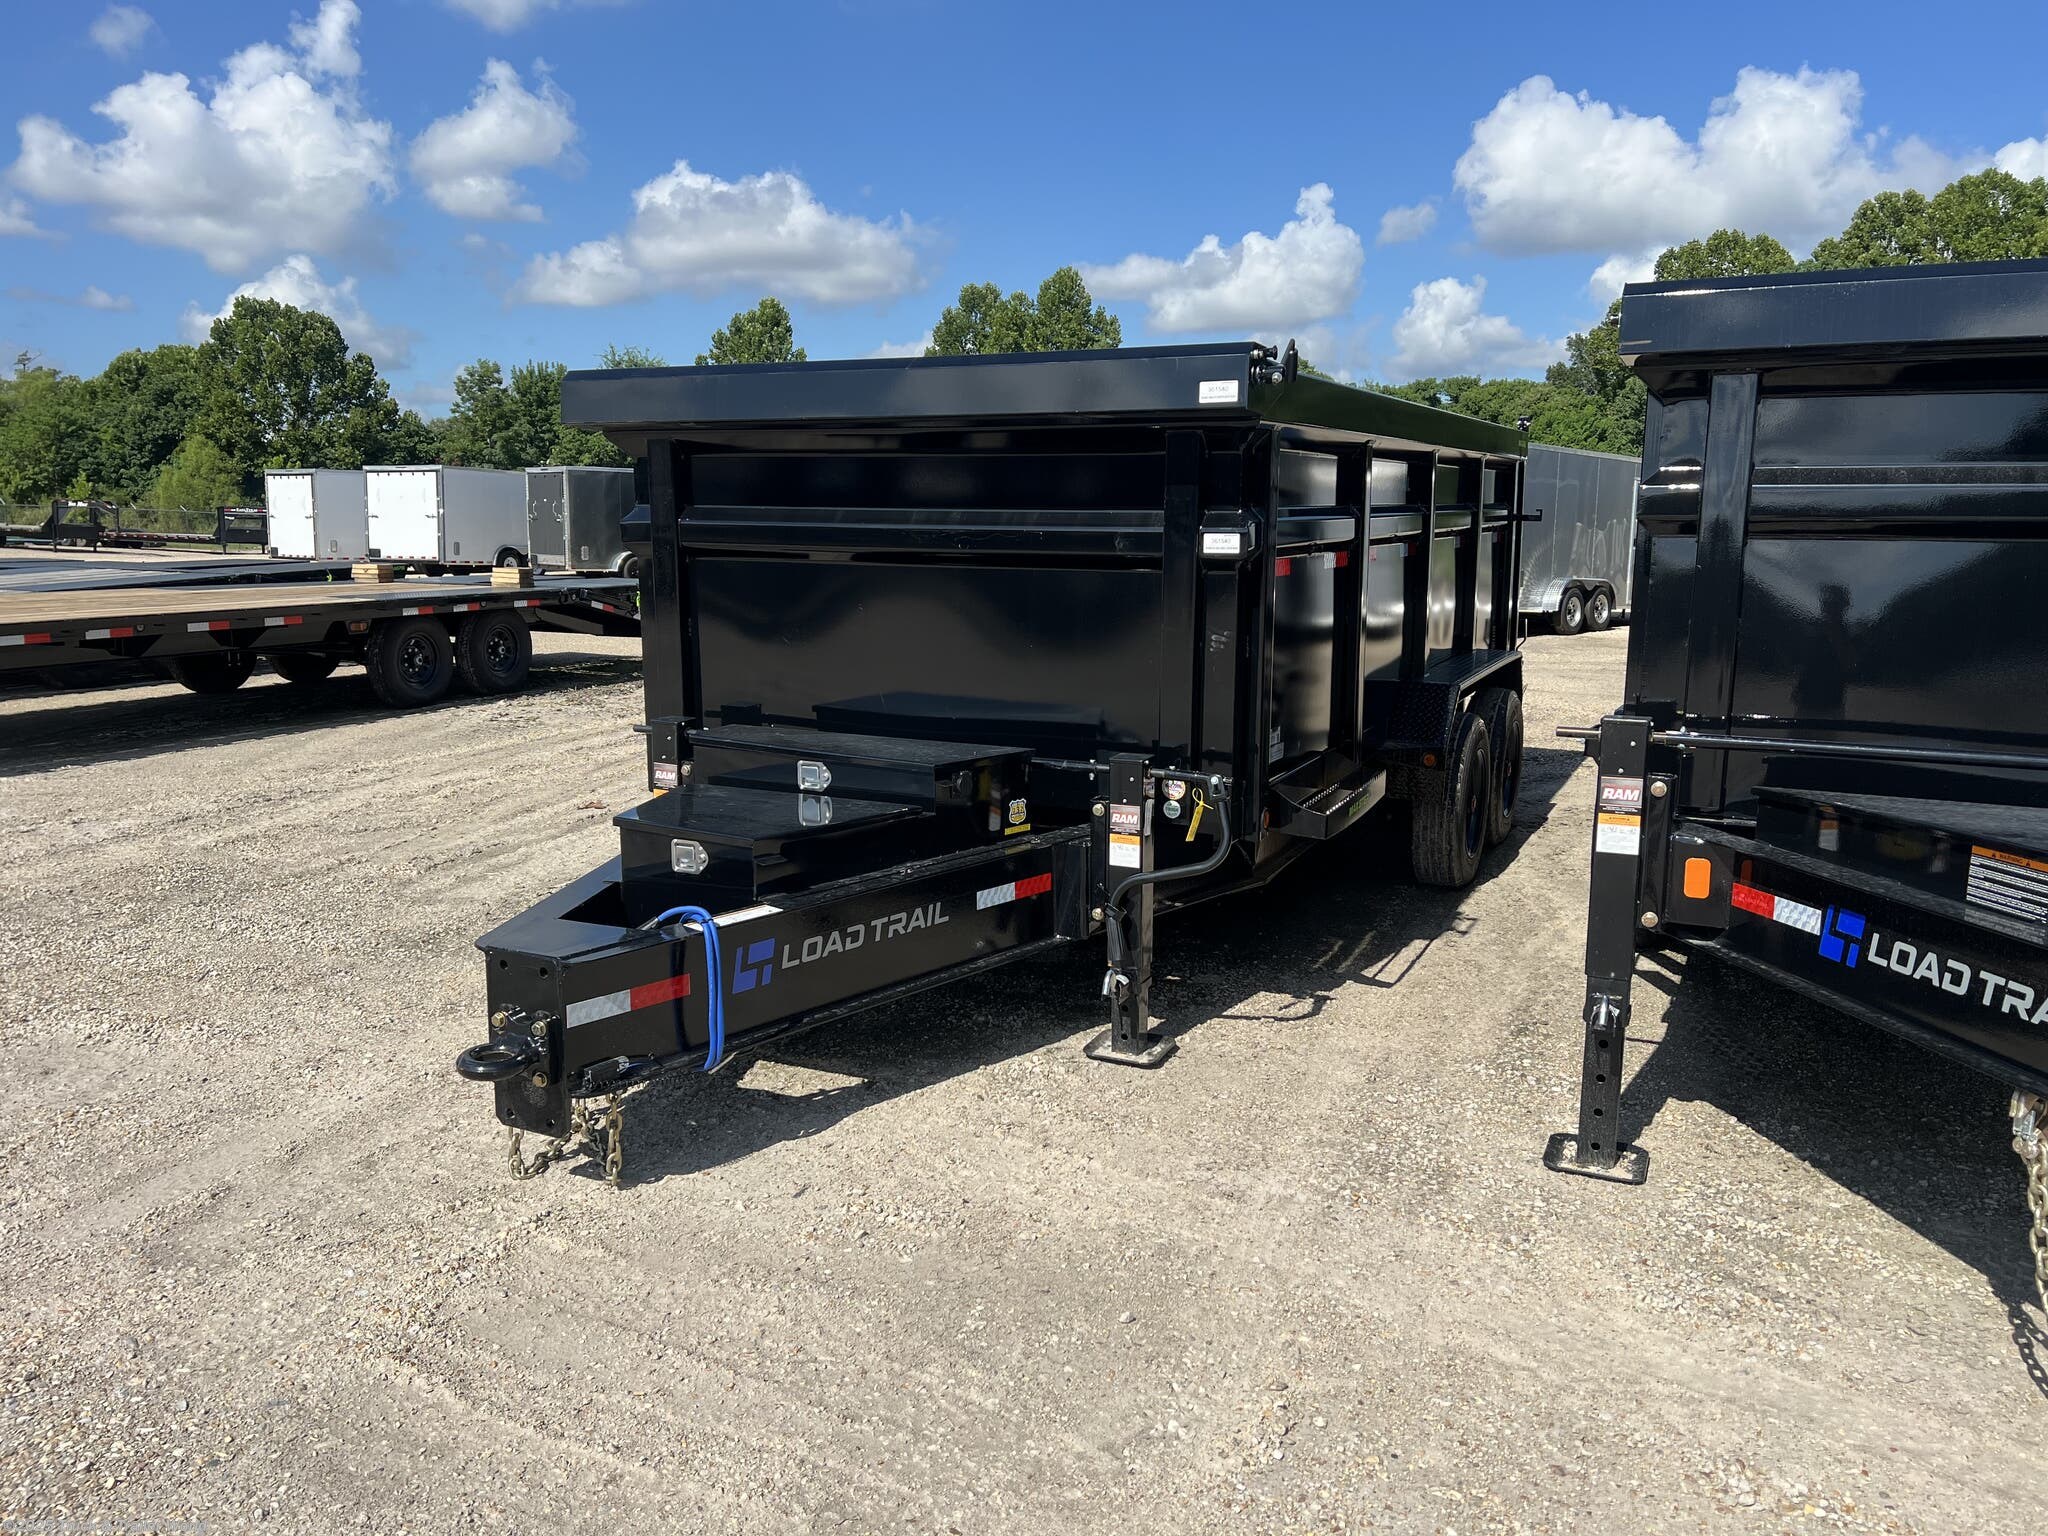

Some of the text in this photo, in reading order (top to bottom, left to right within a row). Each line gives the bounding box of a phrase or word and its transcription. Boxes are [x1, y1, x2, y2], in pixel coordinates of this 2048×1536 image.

[655, 770, 676, 780] RAM
[1602, 787, 1640, 801] RAM
[1112, 813, 1139, 825] RAM
[781, 901, 950, 969] LOAD TRAIL
[1867, 932, 1972, 996] LOAD
